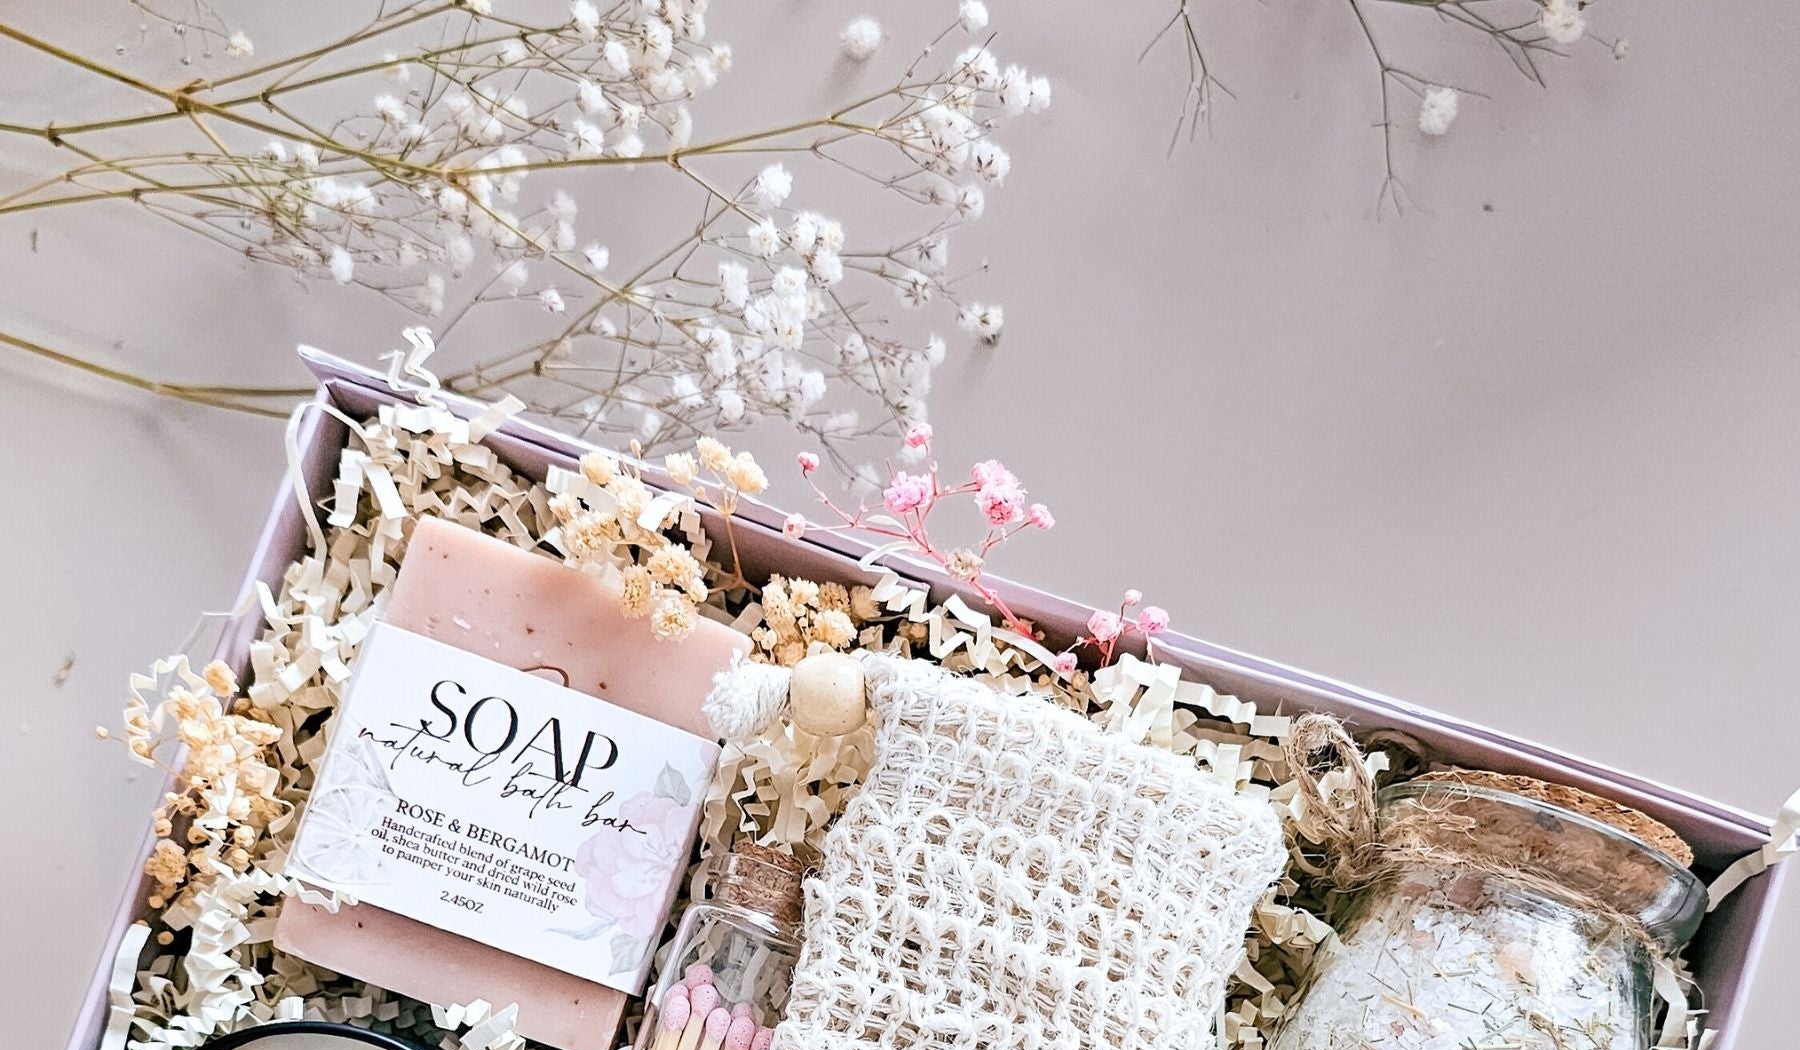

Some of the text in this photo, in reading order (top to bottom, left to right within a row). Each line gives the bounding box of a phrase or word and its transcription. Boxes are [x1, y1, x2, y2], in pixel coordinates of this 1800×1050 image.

[420, 680, 619, 787] SOAP
[358, 719, 647, 834] natural bath bar
[371, 828, 578, 906] oil, shea butter and dried wild rose
[381, 816, 576, 892] Handcrafted blend of grape seed
[395, 798, 575, 872] ROSE & BERGAMOT
[382, 844, 560, 913] to pamper your skin naturally
